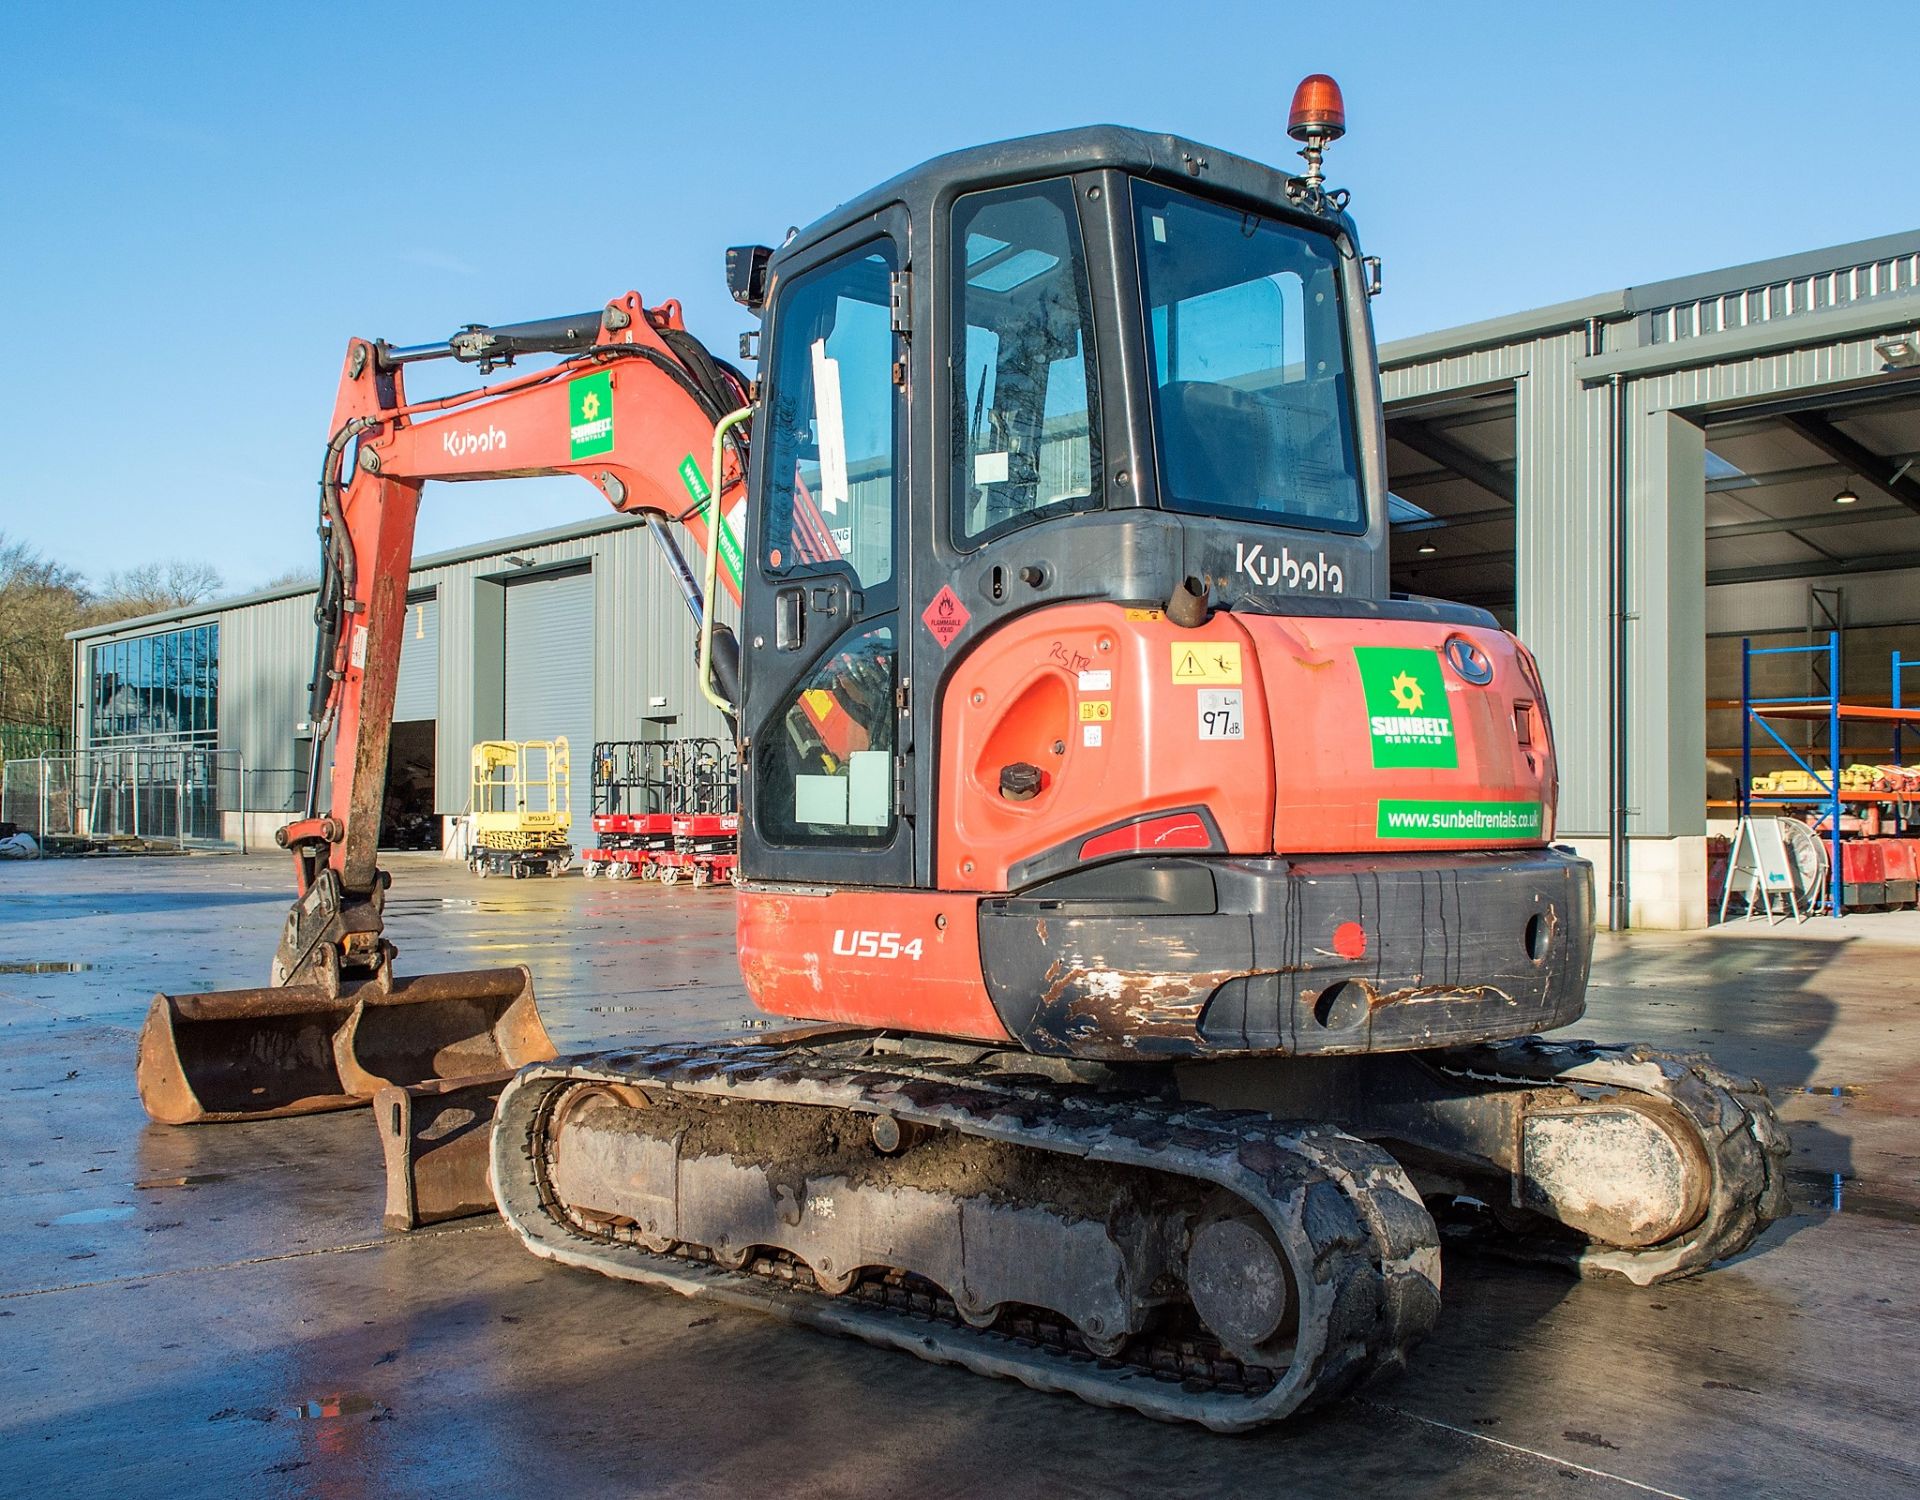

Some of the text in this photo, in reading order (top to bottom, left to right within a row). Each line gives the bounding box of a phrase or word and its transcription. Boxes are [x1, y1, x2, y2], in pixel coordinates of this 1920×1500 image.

[571, 417, 612, 440] SUNBELT
[443, 424, 507, 457] Kubota
[1236, 543, 1343, 593] Kubota
[1203, 711, 1240, 735] 97 dB
[1371, 716, 1449, 737] SUNBELT
[1384, 735, 1442, 745] RENTALS
[1388, 809, 1539, 829] www.sunbeltrentals.co.uk
[832, 929, 923, 961] U55-4
